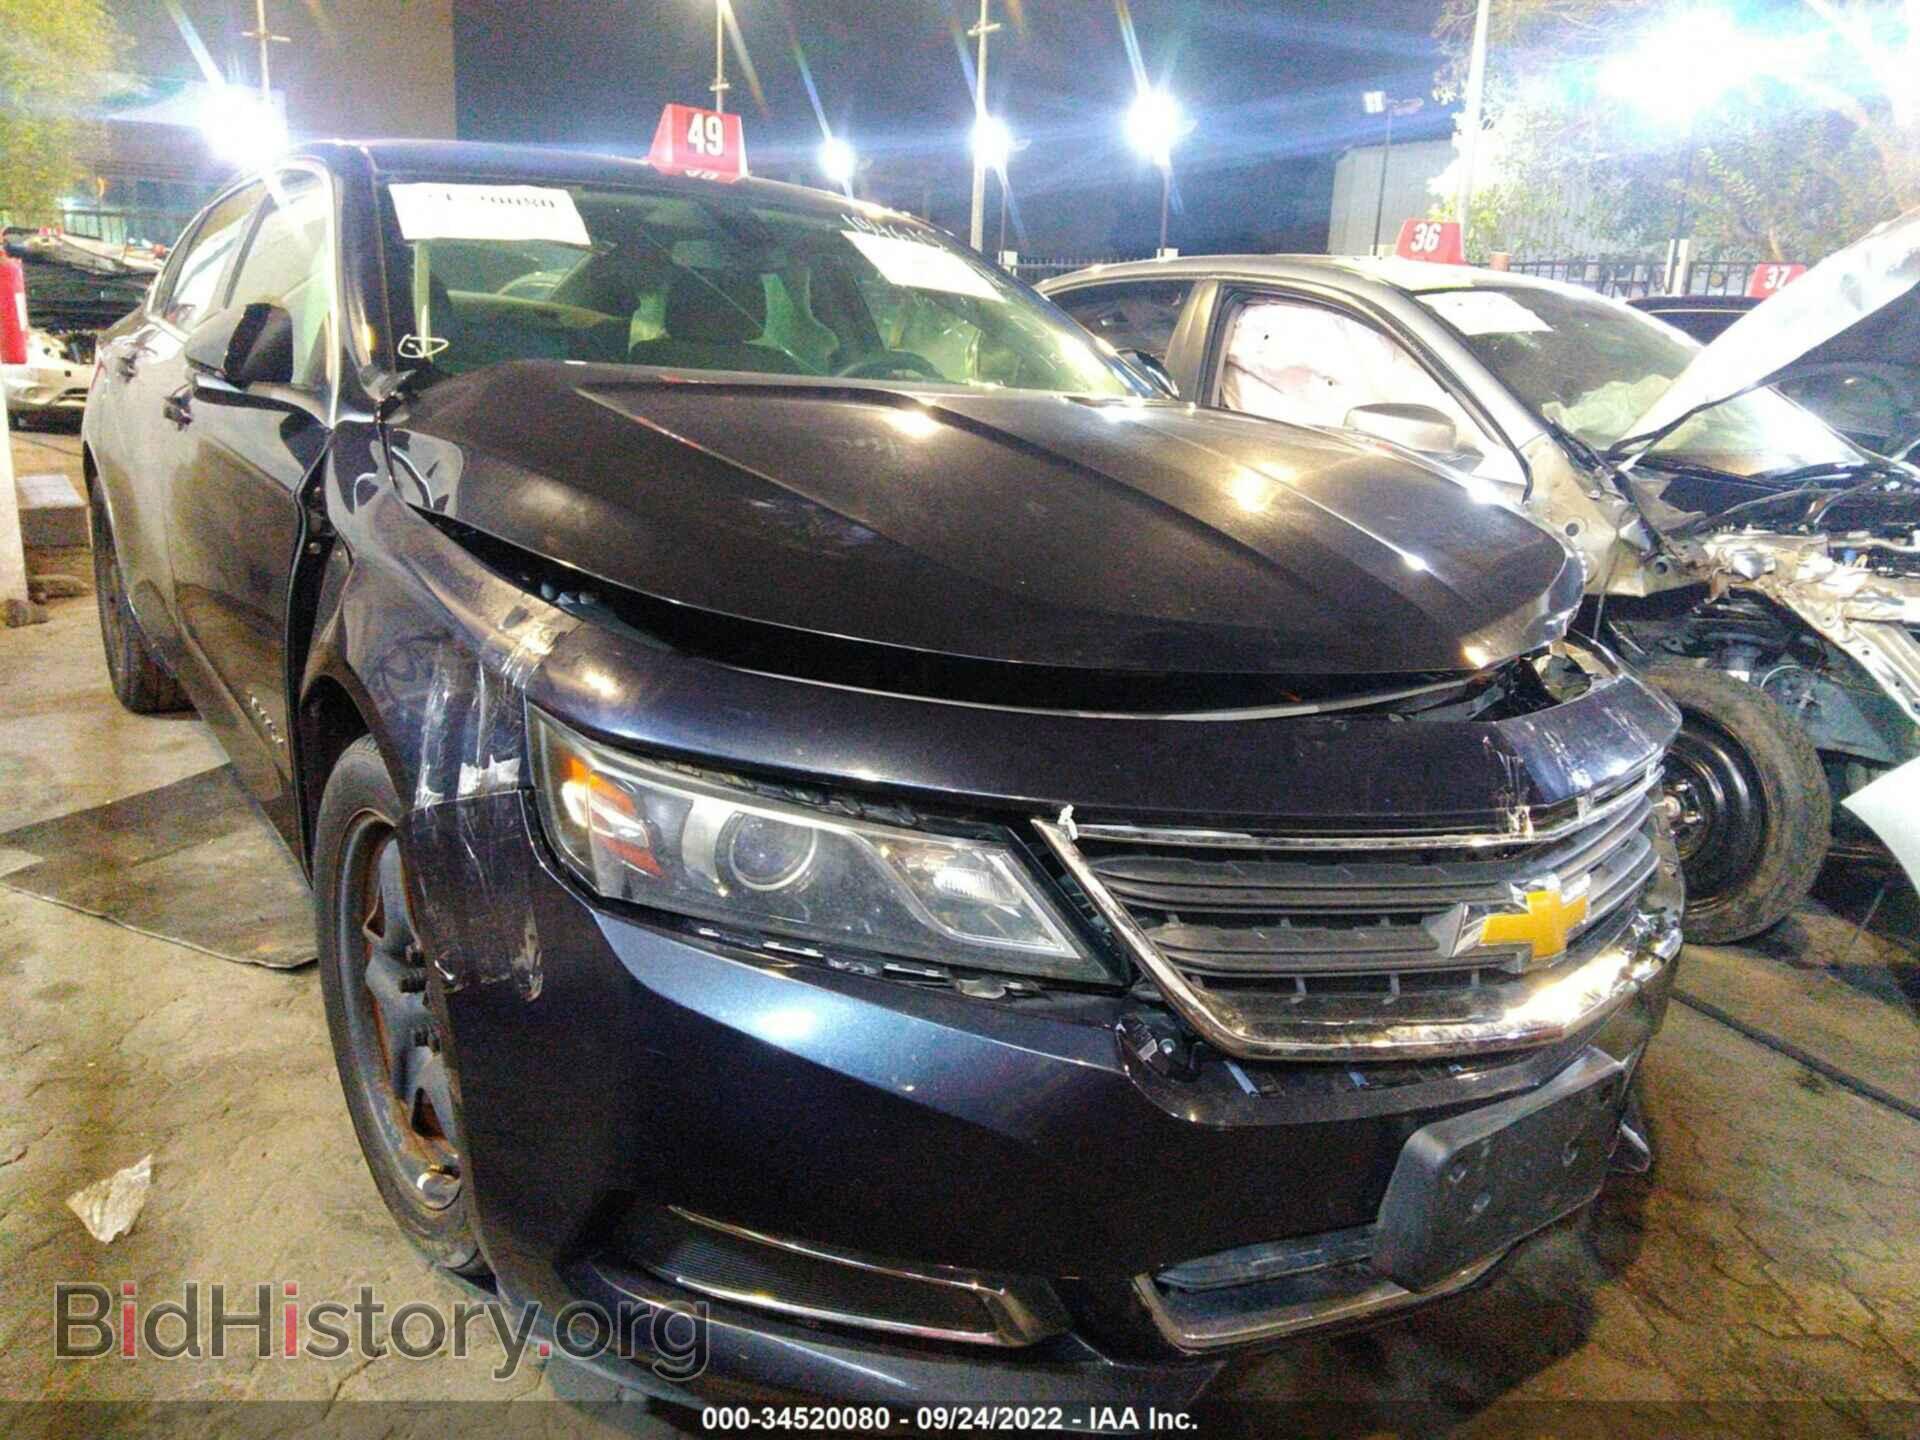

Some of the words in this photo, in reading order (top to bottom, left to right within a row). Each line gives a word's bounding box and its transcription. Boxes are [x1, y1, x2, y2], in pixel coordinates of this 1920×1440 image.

[688, 112, 724, 157] 49
[1409, 223, 1442, 254] 36
[1764, 264, 1792, 291] 37
